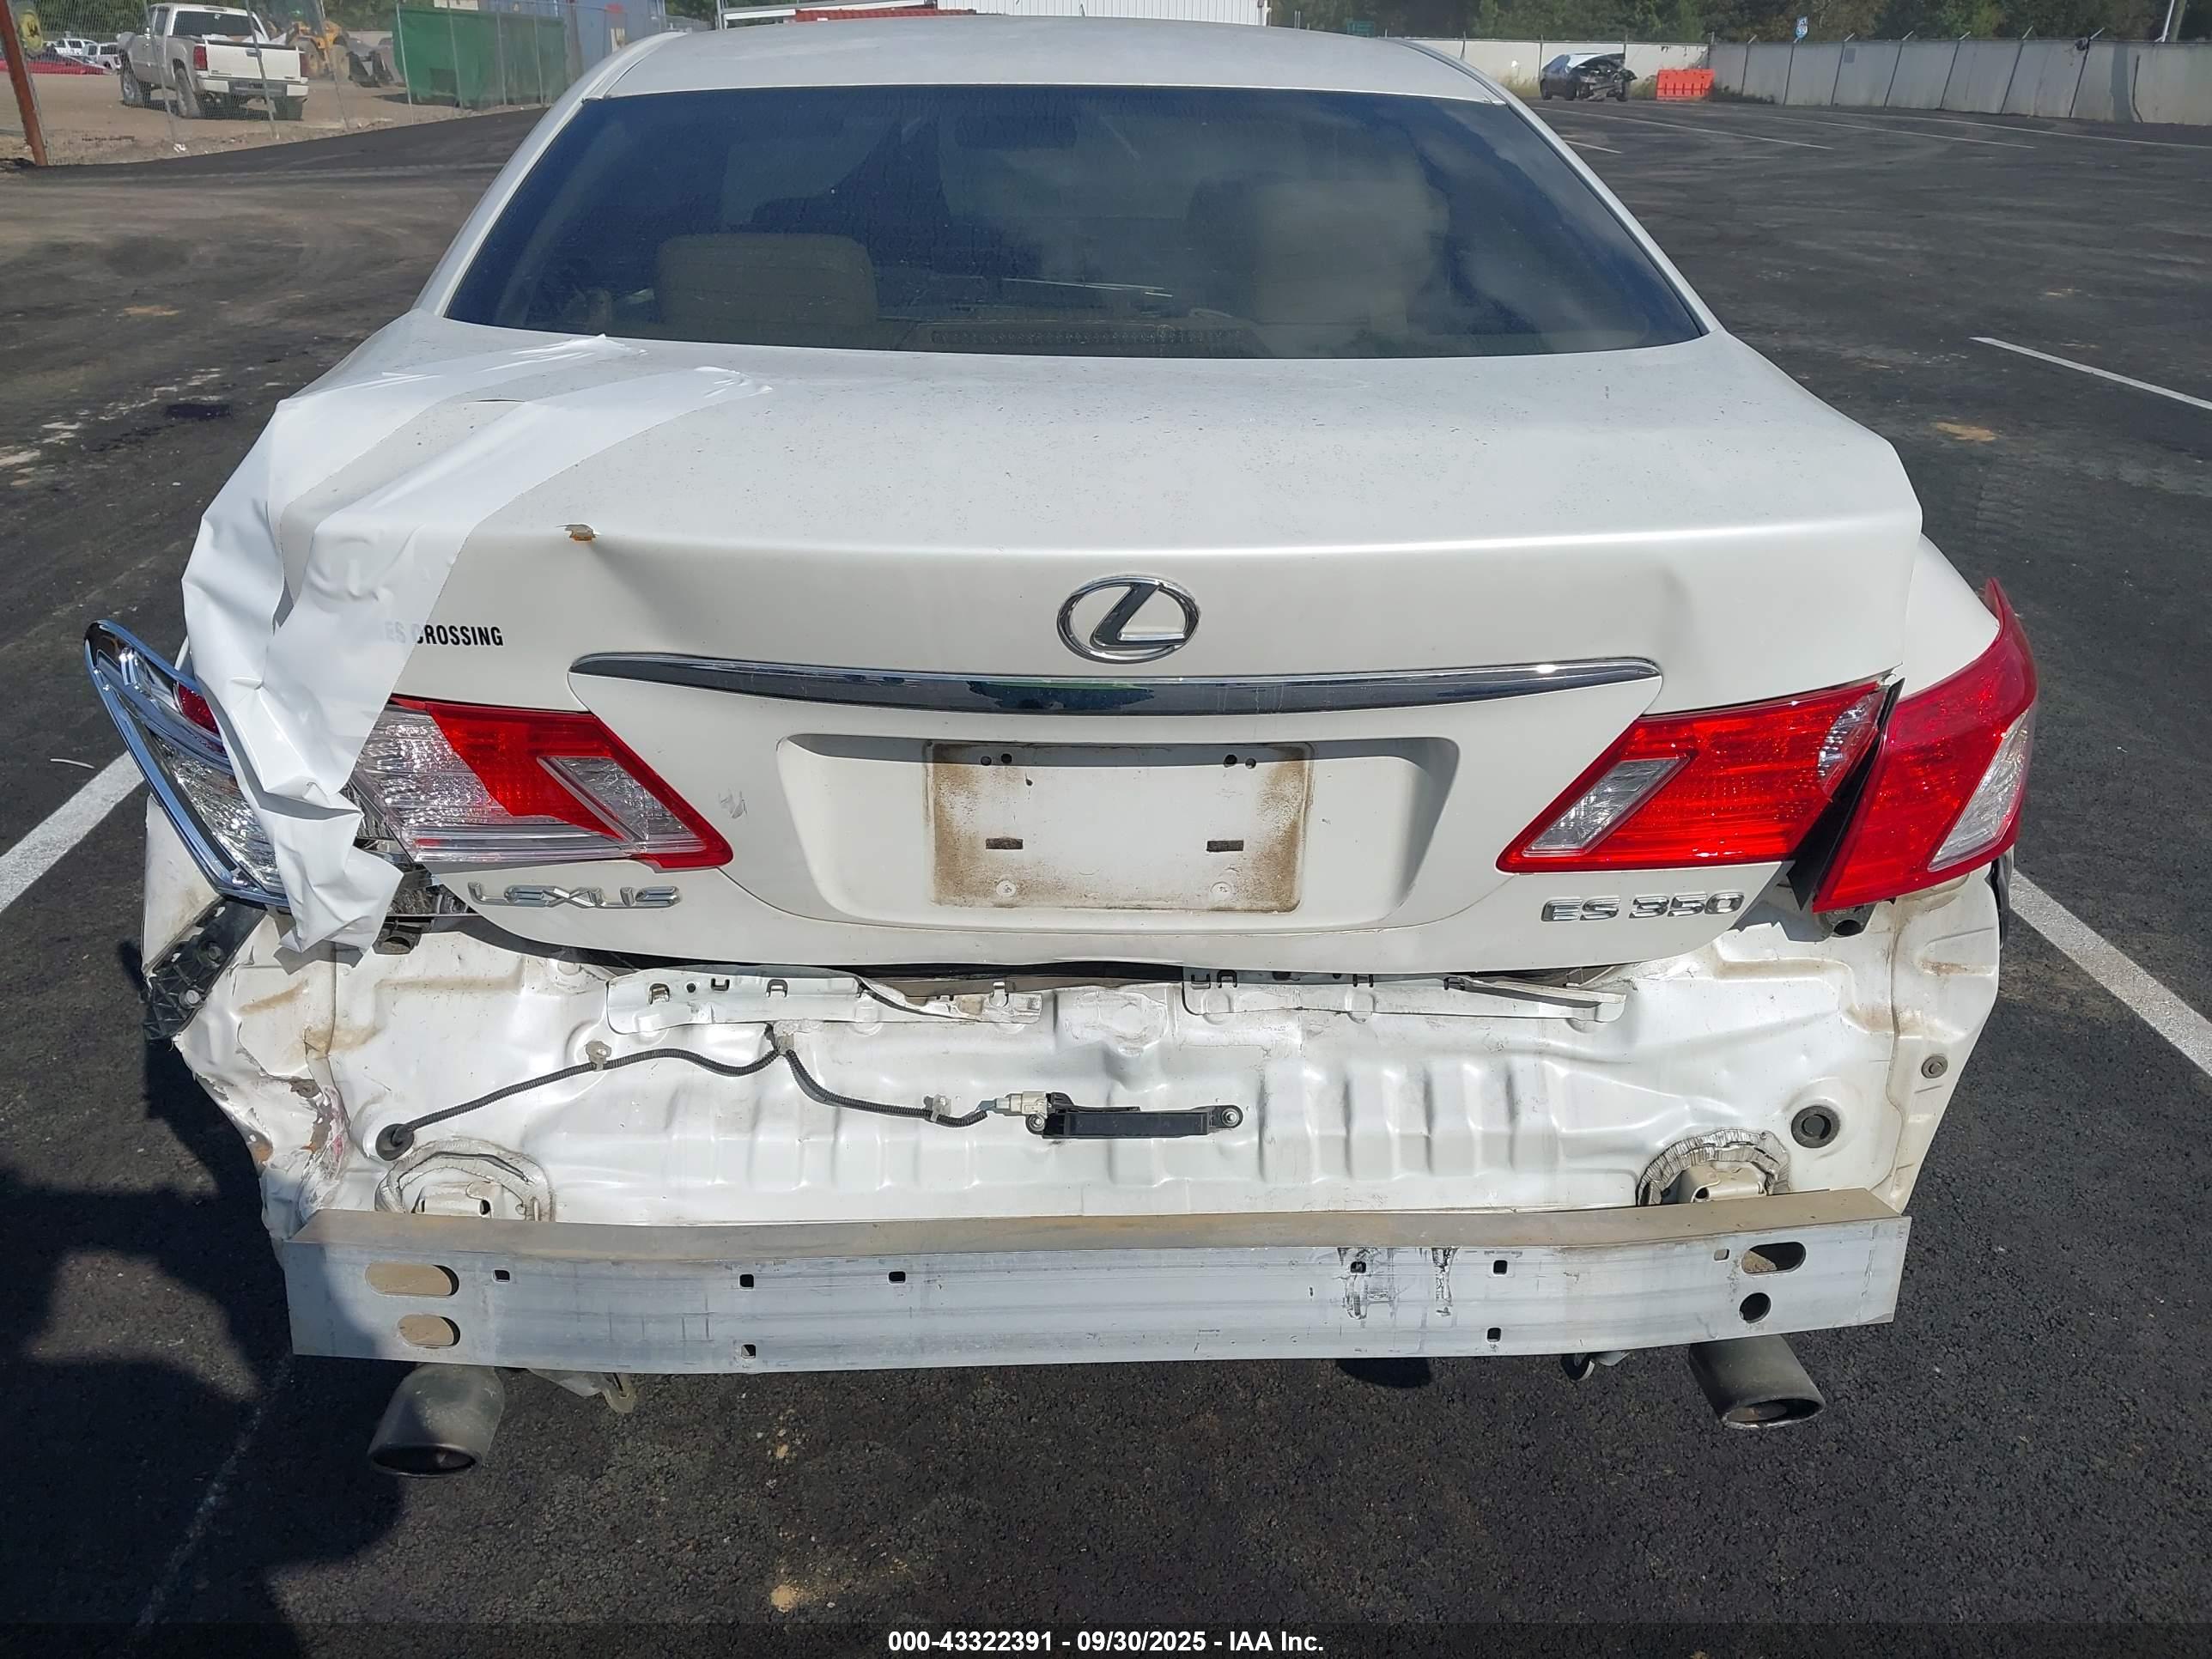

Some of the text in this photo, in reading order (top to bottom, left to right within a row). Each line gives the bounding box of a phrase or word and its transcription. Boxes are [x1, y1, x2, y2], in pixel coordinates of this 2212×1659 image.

[467, 881, 683, 909] LEXUS
[1540, 890, 1746, 922] ES 350
